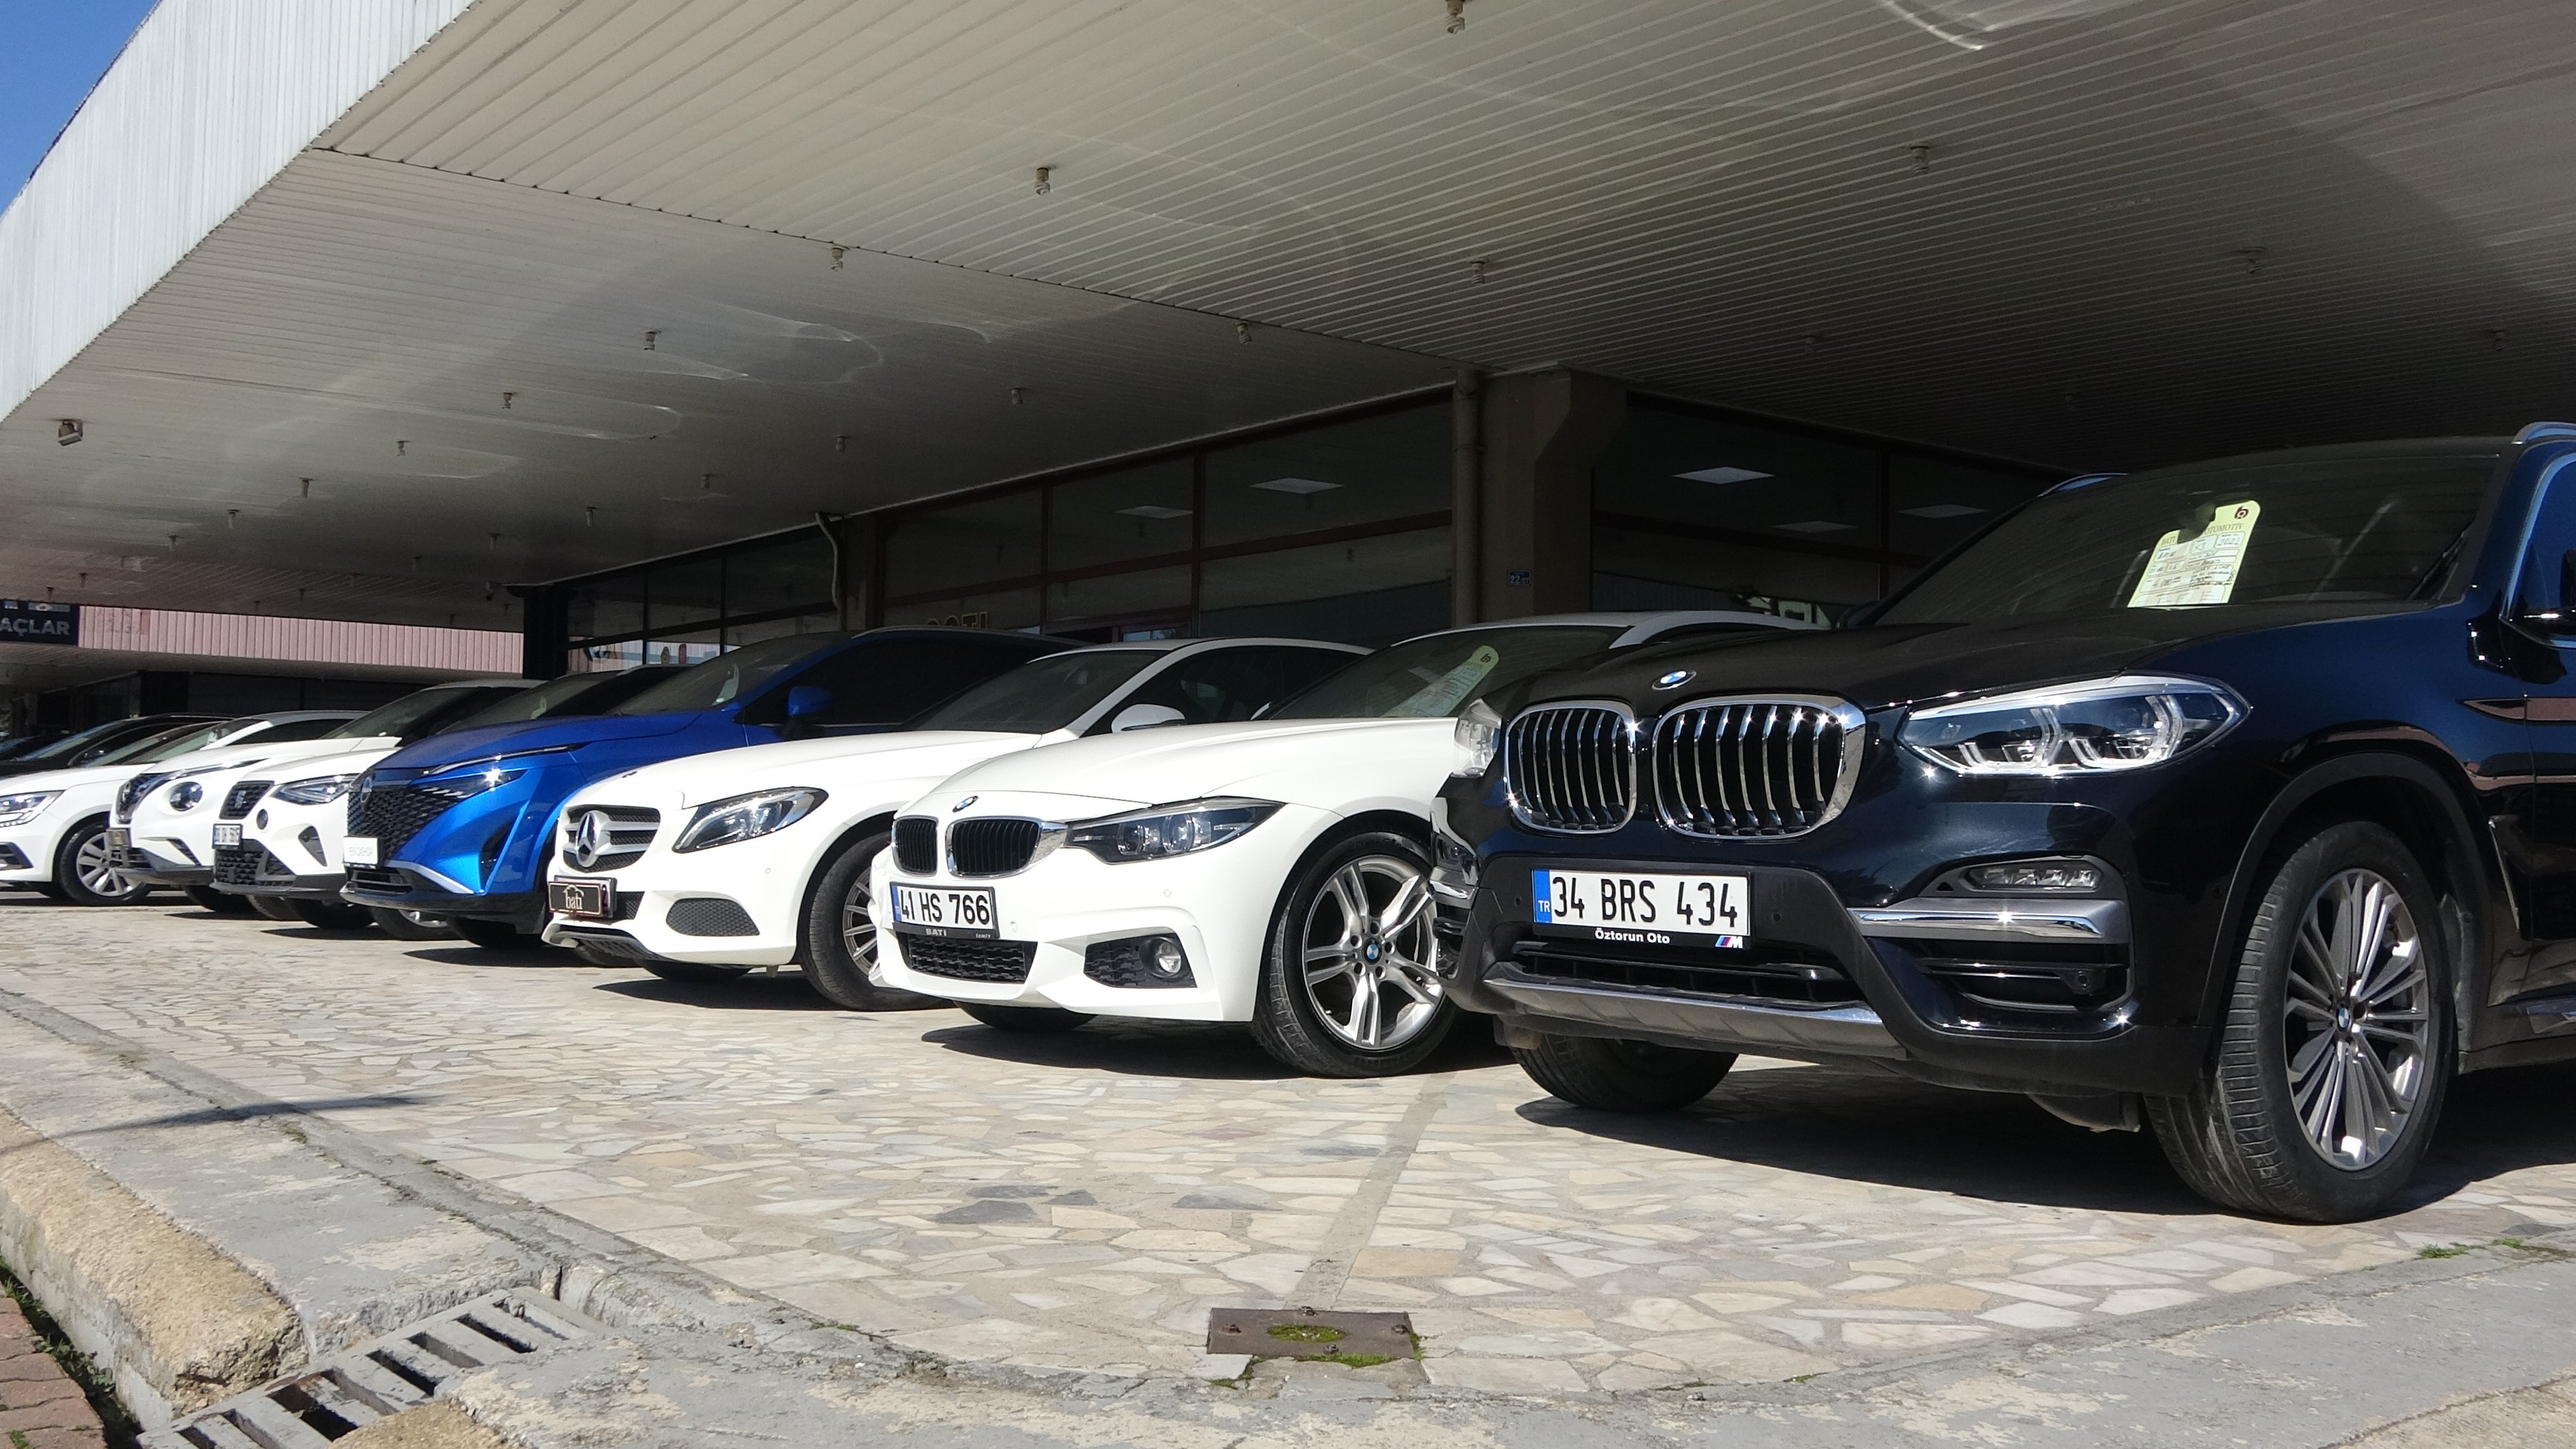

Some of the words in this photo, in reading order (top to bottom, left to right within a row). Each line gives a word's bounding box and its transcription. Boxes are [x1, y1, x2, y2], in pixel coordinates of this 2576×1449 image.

[0, 617, 70, 637] AÇLAR
[900, 890, 915, 920] 41
[919, 892, 942, 922] HS
[949, 894, 989, 925] 766
[1538, 900, 1550, 913] TR
[1552, 876, 1585, 919] 34
[1601, 878, 1656, 923] BRS
[1677, 881, 1738, 928] 434
[1595, 927, 1644, 942] Öztorun
[1647, 932, 1670, 944] Oto
